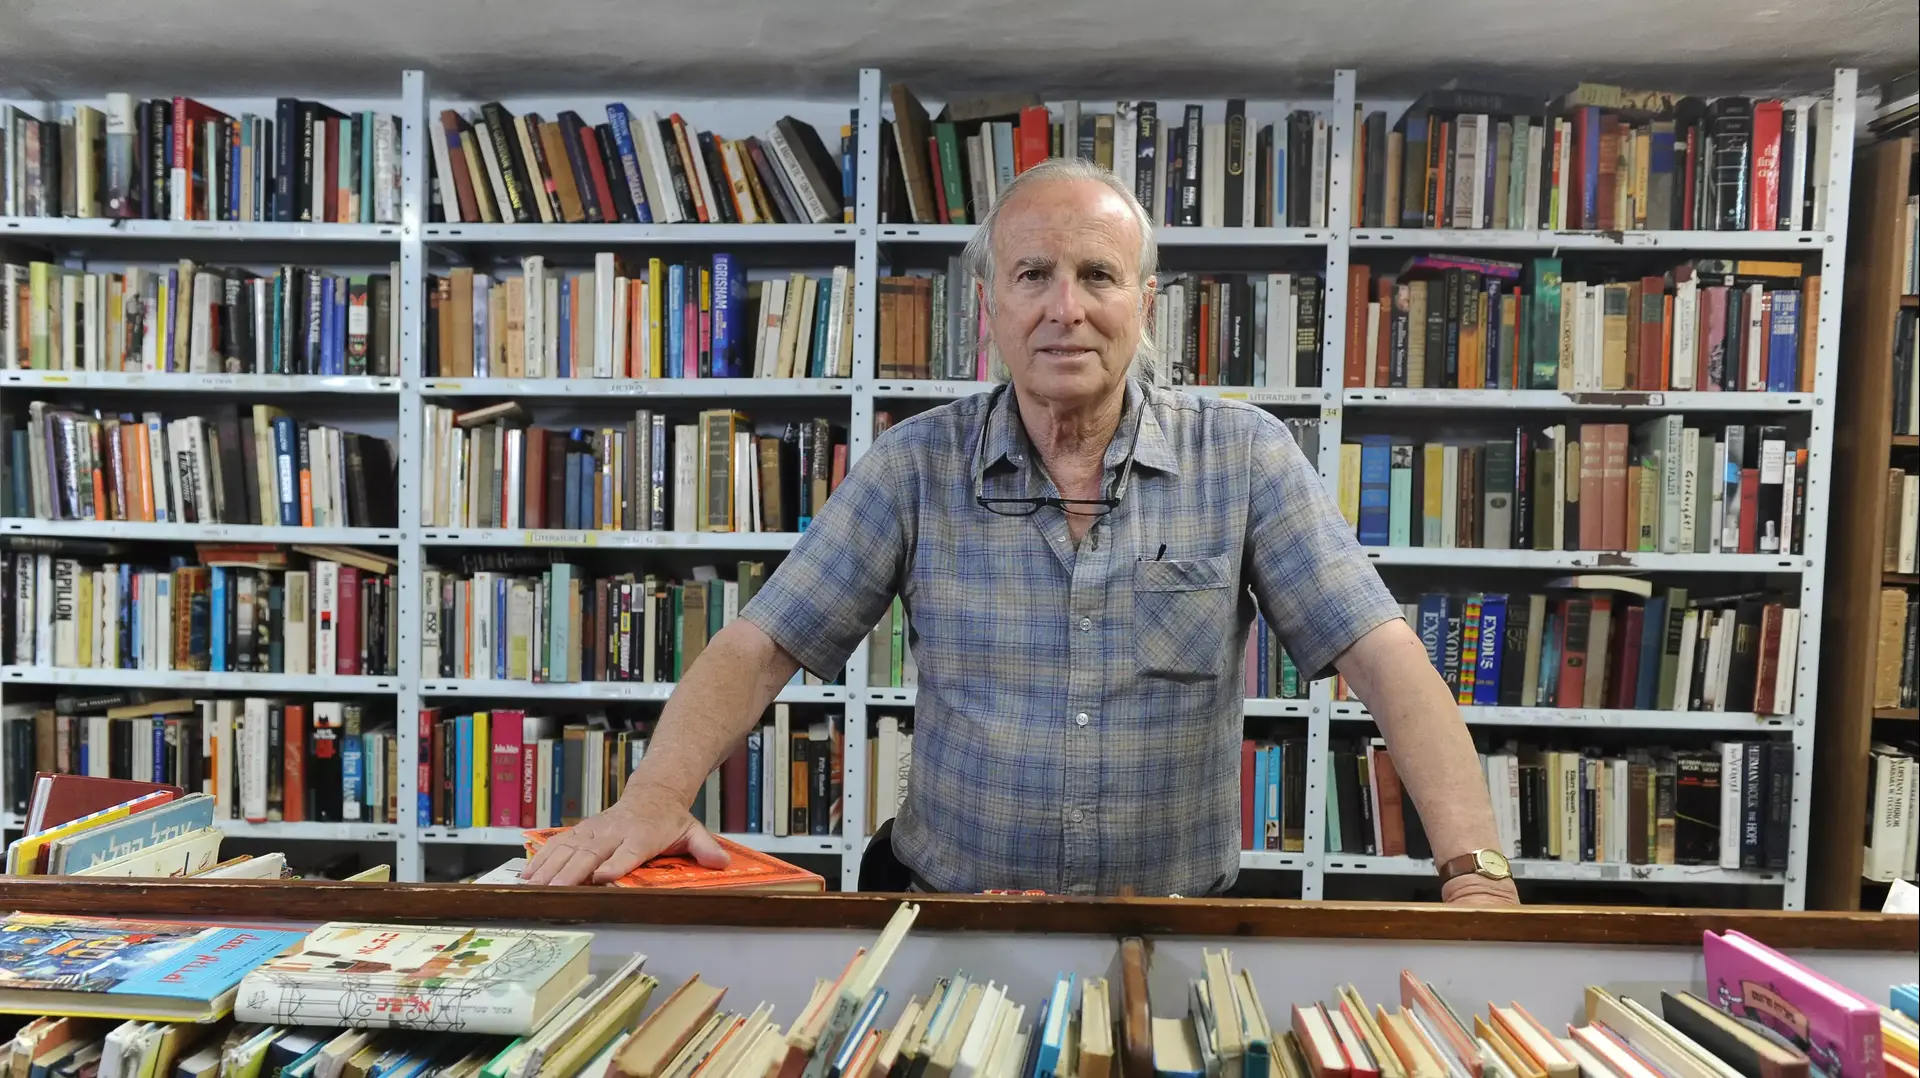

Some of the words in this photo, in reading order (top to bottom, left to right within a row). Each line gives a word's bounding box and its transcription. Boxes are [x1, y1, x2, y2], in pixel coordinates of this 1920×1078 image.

[226, 278, 241, 306] After
[715, 264, 729, 317] GRISHAM
[1249, 392, 1296, 402] LITERATURE
[1681, 470, 1695, 531] Goodnight!
[19, 556, 32, 600] Siegfried
[56, 559, 75, 621] PAPILLON
[1443, 616, 1461, 684] EXODUS
[1480, 615, 1497, 669] EXODUS
[522, 748, 534, 803] MUDBOUND
[897, 752, 912, 807] NABOKO
[1748, 745, 1761, 781] HERMAN
[1894, 766, 1905, 795] DISTANT
[1746, 822, 1760, 845] HOPE
[1892, 798, 1902, 828] MIRROR
